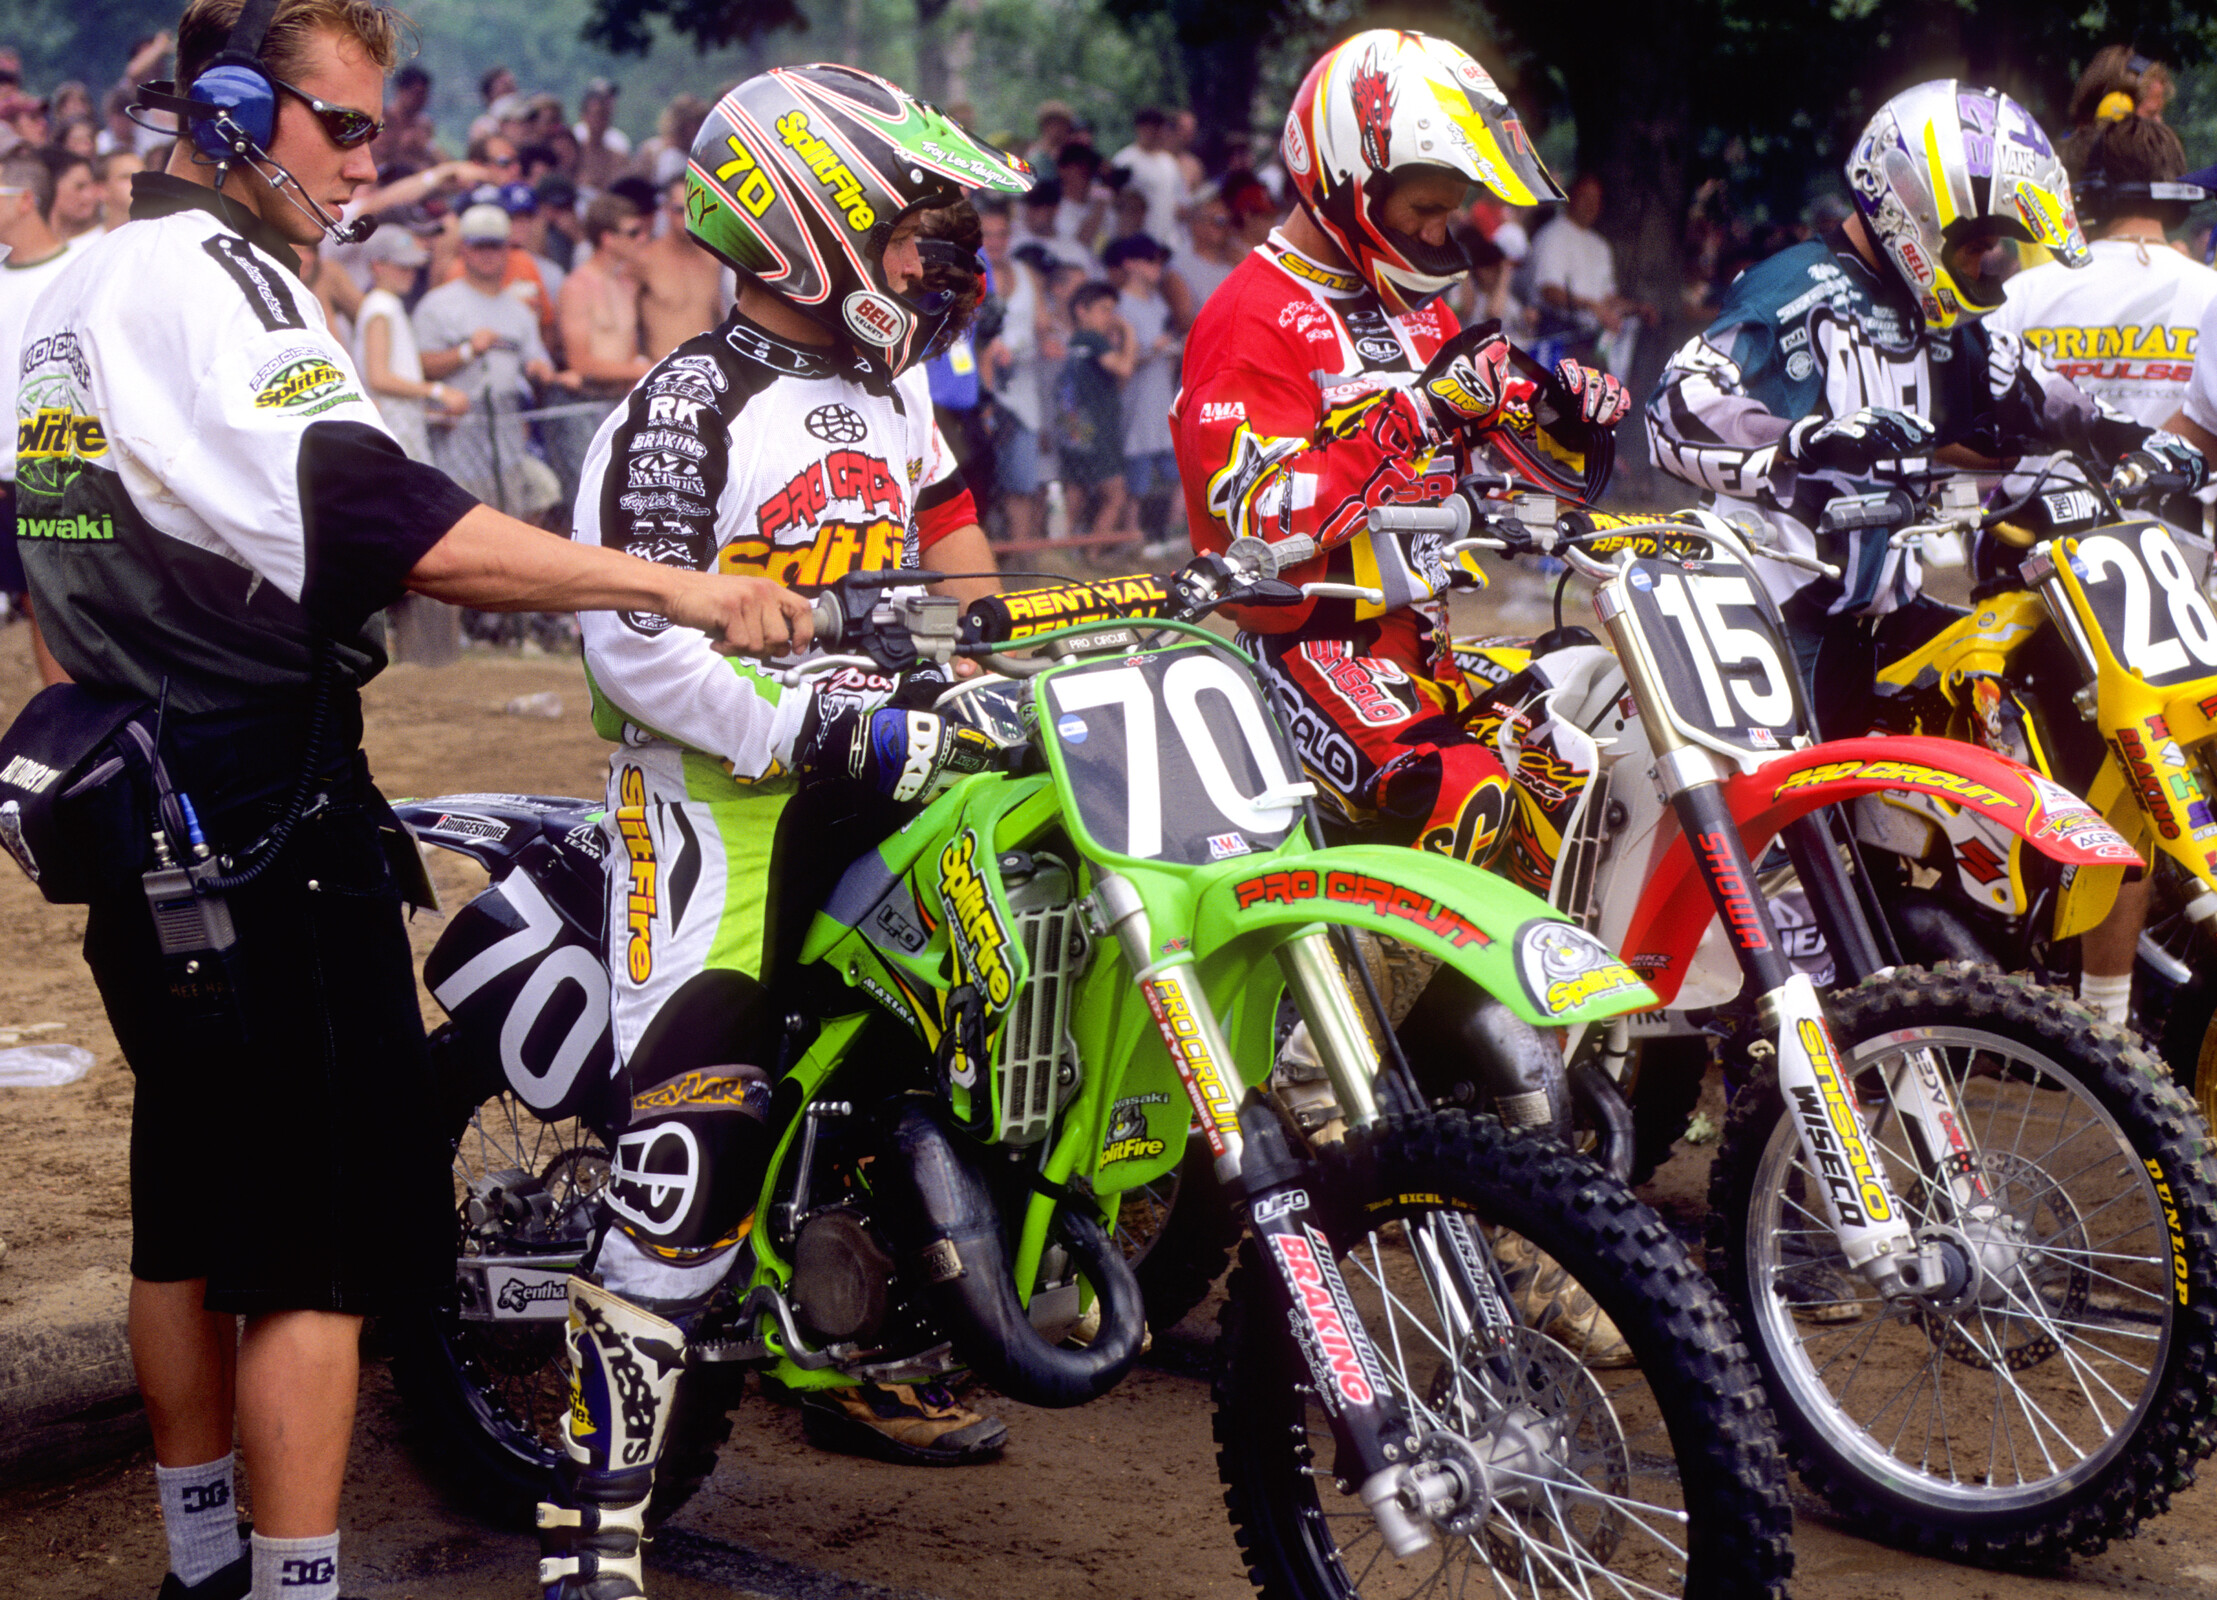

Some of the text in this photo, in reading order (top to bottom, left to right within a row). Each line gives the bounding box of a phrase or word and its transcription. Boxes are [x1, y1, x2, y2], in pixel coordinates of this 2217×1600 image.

[716, 136, 776, 219] 70
[775, 110, 876, 232] SplitFire
[921, 142, 950, 162] Troy
[951, 153, 969, 168] Lee
[968, 161, 1019, 189] Designs
[1280, 251, 1363, 293] SINIS
[1901, 242, 1932, 283] BELL
[855, 298, 900, 337] BELL
[2023, 324, 2199, 361] PRIMAL
[249, 357, 280, 391] PRO
[254, 365, 347, 409] SplitFire
[648, 396, 707, 429] RK
[1200, 401, 1246, 417] AMA
[629, 429, 708, 460] BRAKING
[756, 458, 828, 540] PRO
[1002, 577, 1167, 622] RENTHAL
[2076, 526, 2217, 678] 28
[1069, 631, 1128, 649] PRO CIRCUIT
[1652, 574, 1794, 727] 15
[1050, 655, 1294, 858] 70
[1773, 761, 1865, 803] PRO
[1853, 760, 2022, 808] CIRCUIT
[2116, 727, 2181, 840] BRAKING
[431, 813, 511, 843] BRIDGESTONE
[564, 836, 601, 860] TEAM
[1211, 834, 1246, 852] AMA
[616, 762, 658, 986] SlitFire
[1698, 832, 1768, 949] SHOWA
[938, 834, 1015, 1012] SplitFire
[1235, 868, 1497, 951] PRO CIRCUIT
[434, 866, 611, 1110] 70
[863, 976, 917, 1028] MAXIMA
[1153, 978, 1243, 1137] PRO CIRCUIT
[633, 1072, 745, 1110] KEVLAR
[1106, 1092, 1171, 1110] wasaki
[1159, 1021, 1225, 1153] KYB WORKS KIT
[1797, 1017, 1892, 1223] SINISALO
[1099, 1138, 1166, 1172] plitFire
[1790, 1085, 1867, 1229] WISECO
[1399, 1192, 1444, 1204] EXCEL
[2143, 1158, 2189, 1306] DUNLOP
[497, 1277, 570, 1313] Rentha
[1302, 1221, 1393, 1399] BRIDGESTONE
[1275, 1232, 1375, 1407] BRAKING
